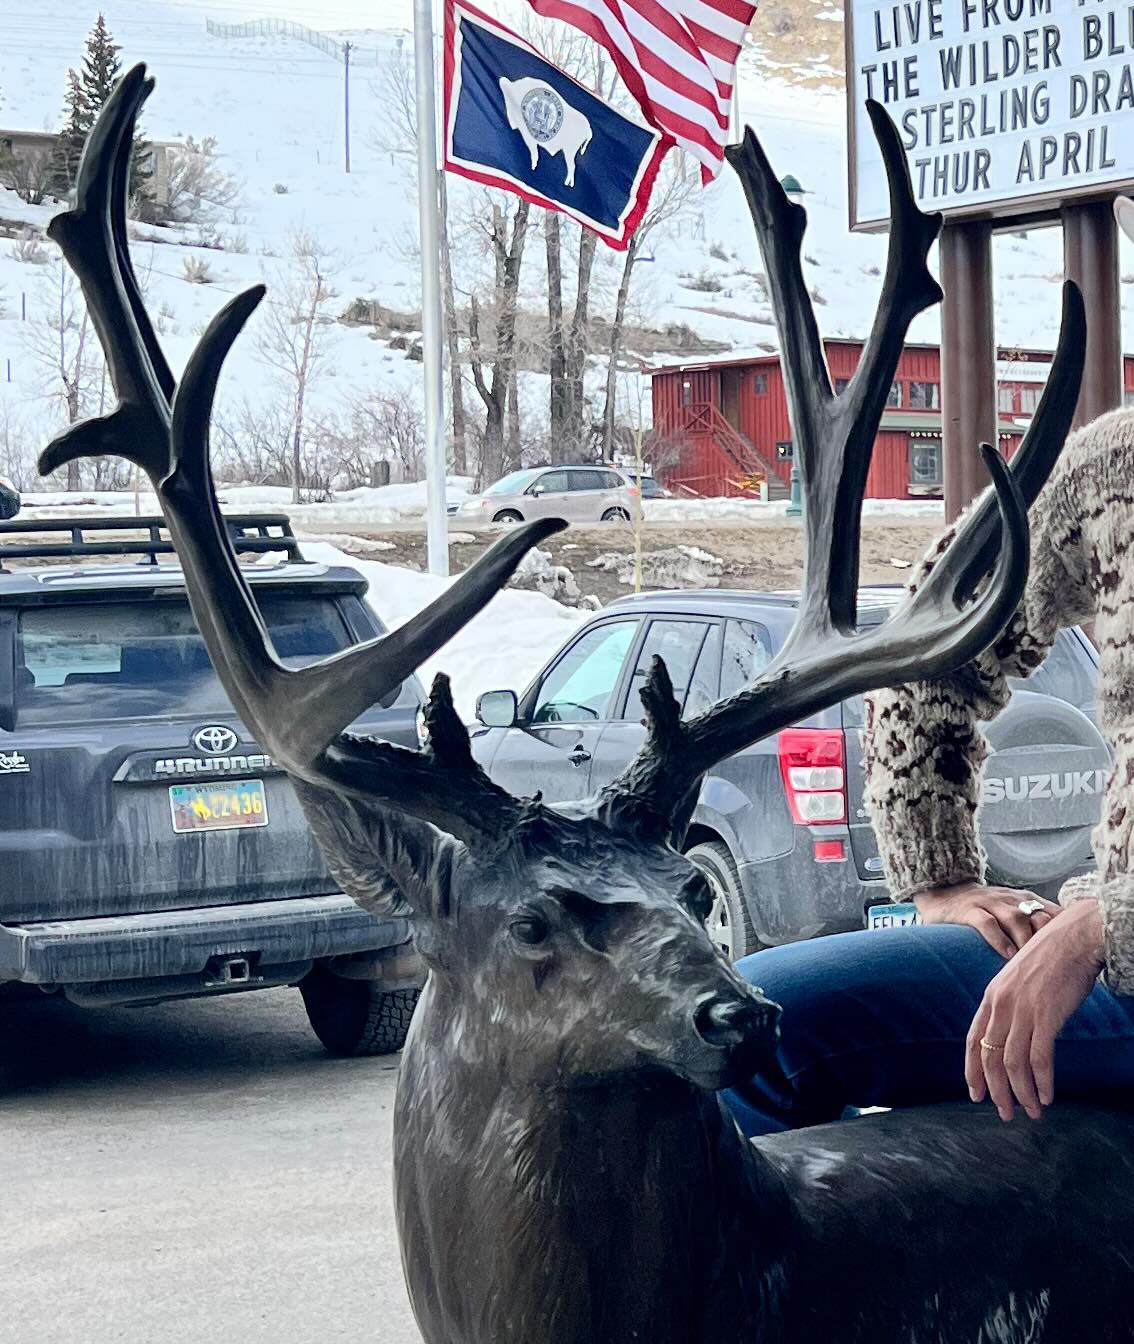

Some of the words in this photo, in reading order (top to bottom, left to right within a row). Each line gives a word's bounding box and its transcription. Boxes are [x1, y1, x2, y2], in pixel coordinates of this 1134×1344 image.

[862, 55, 919, 104] THE
[940, 24, 1062, 90] WILDER
[902, 80, 1049, 150] STERLING
[915, 148, 990, 200] THUR
[1016, 125, 1115, 184] APRIL
[984, 769, 1112, 803] SUZUKI
